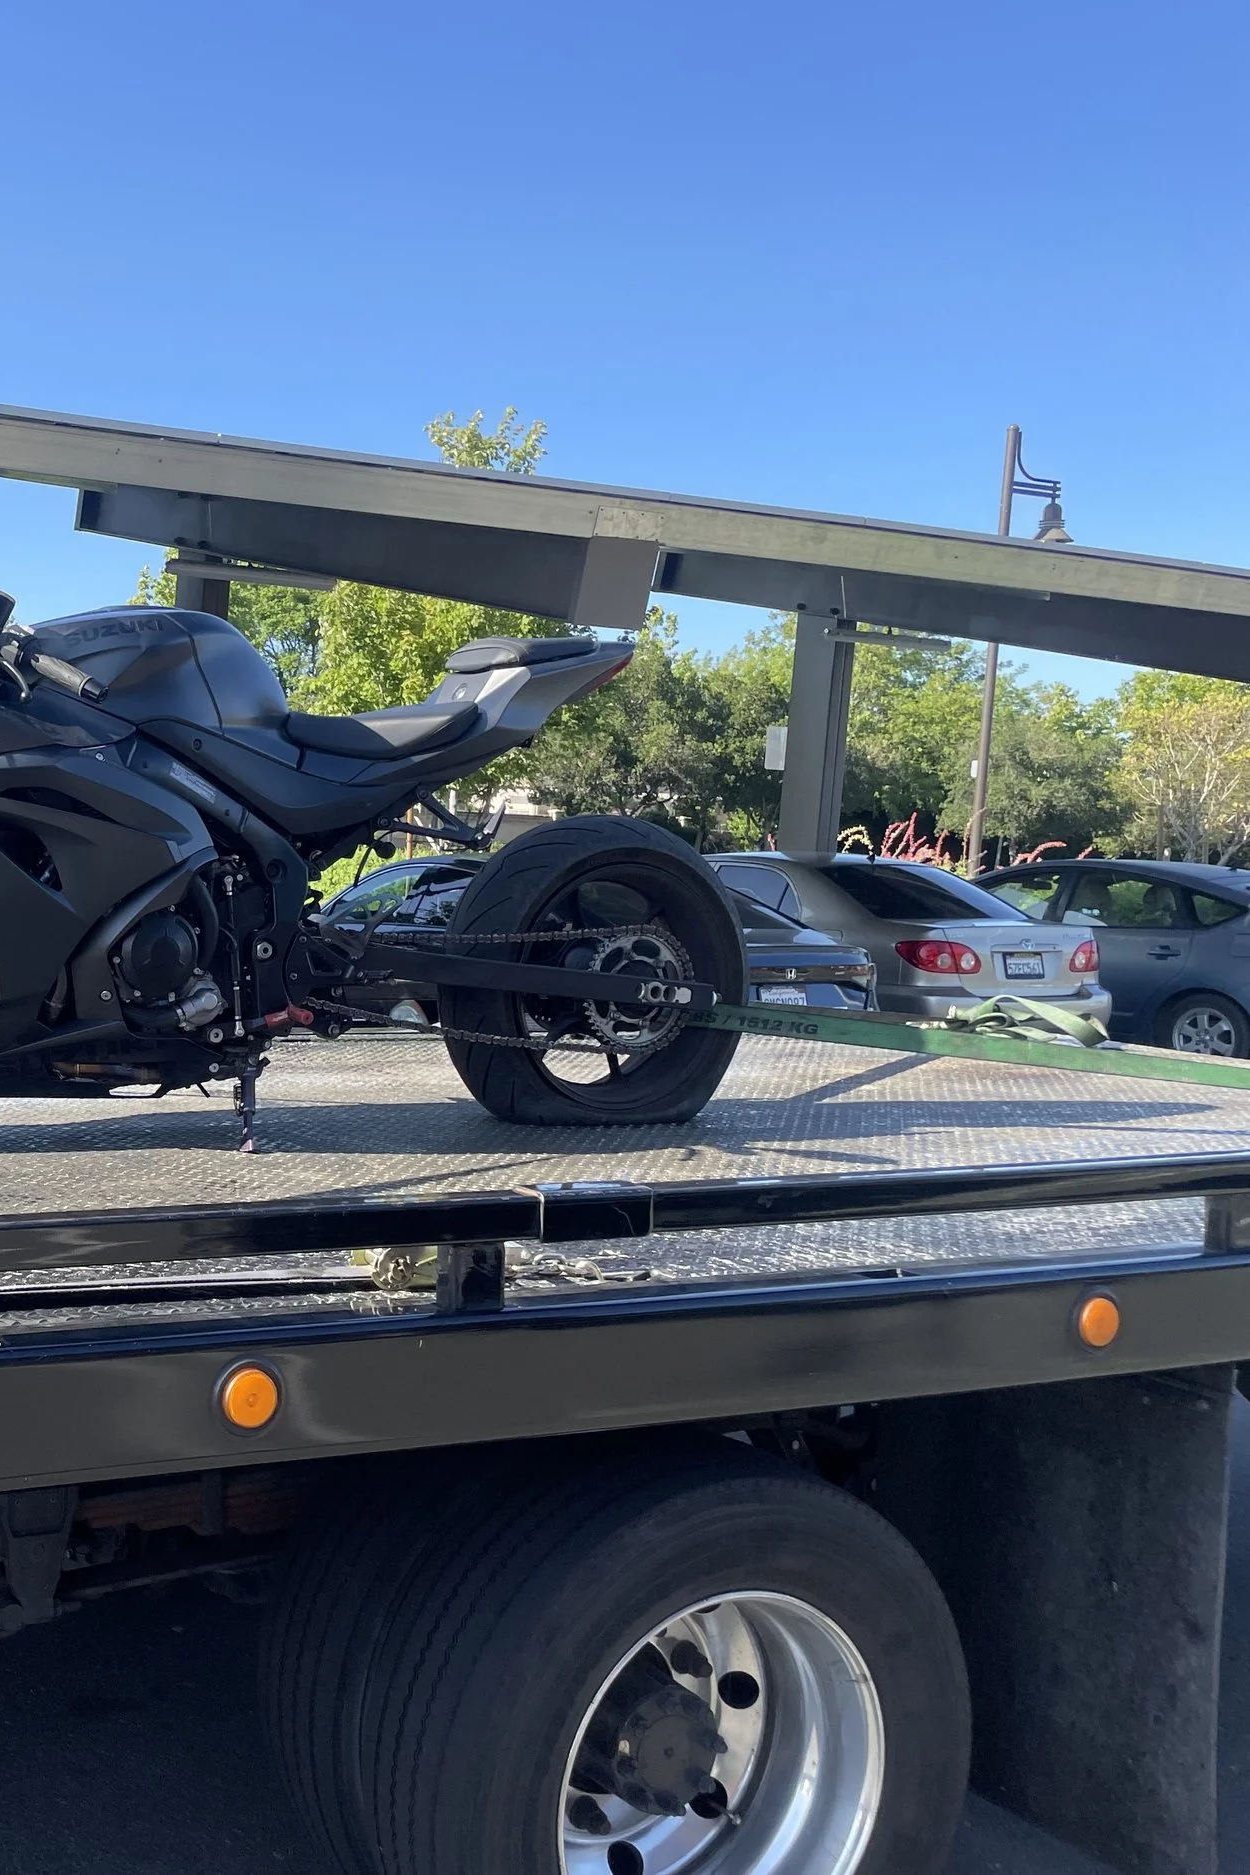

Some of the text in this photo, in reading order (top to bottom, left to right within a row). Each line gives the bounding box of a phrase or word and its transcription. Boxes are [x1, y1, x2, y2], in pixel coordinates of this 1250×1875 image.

[63, 619, 164, 645] SUZUKI
[739, 1015, 783, 1032] 1512
[788, 1020, 819, 1035] KG
